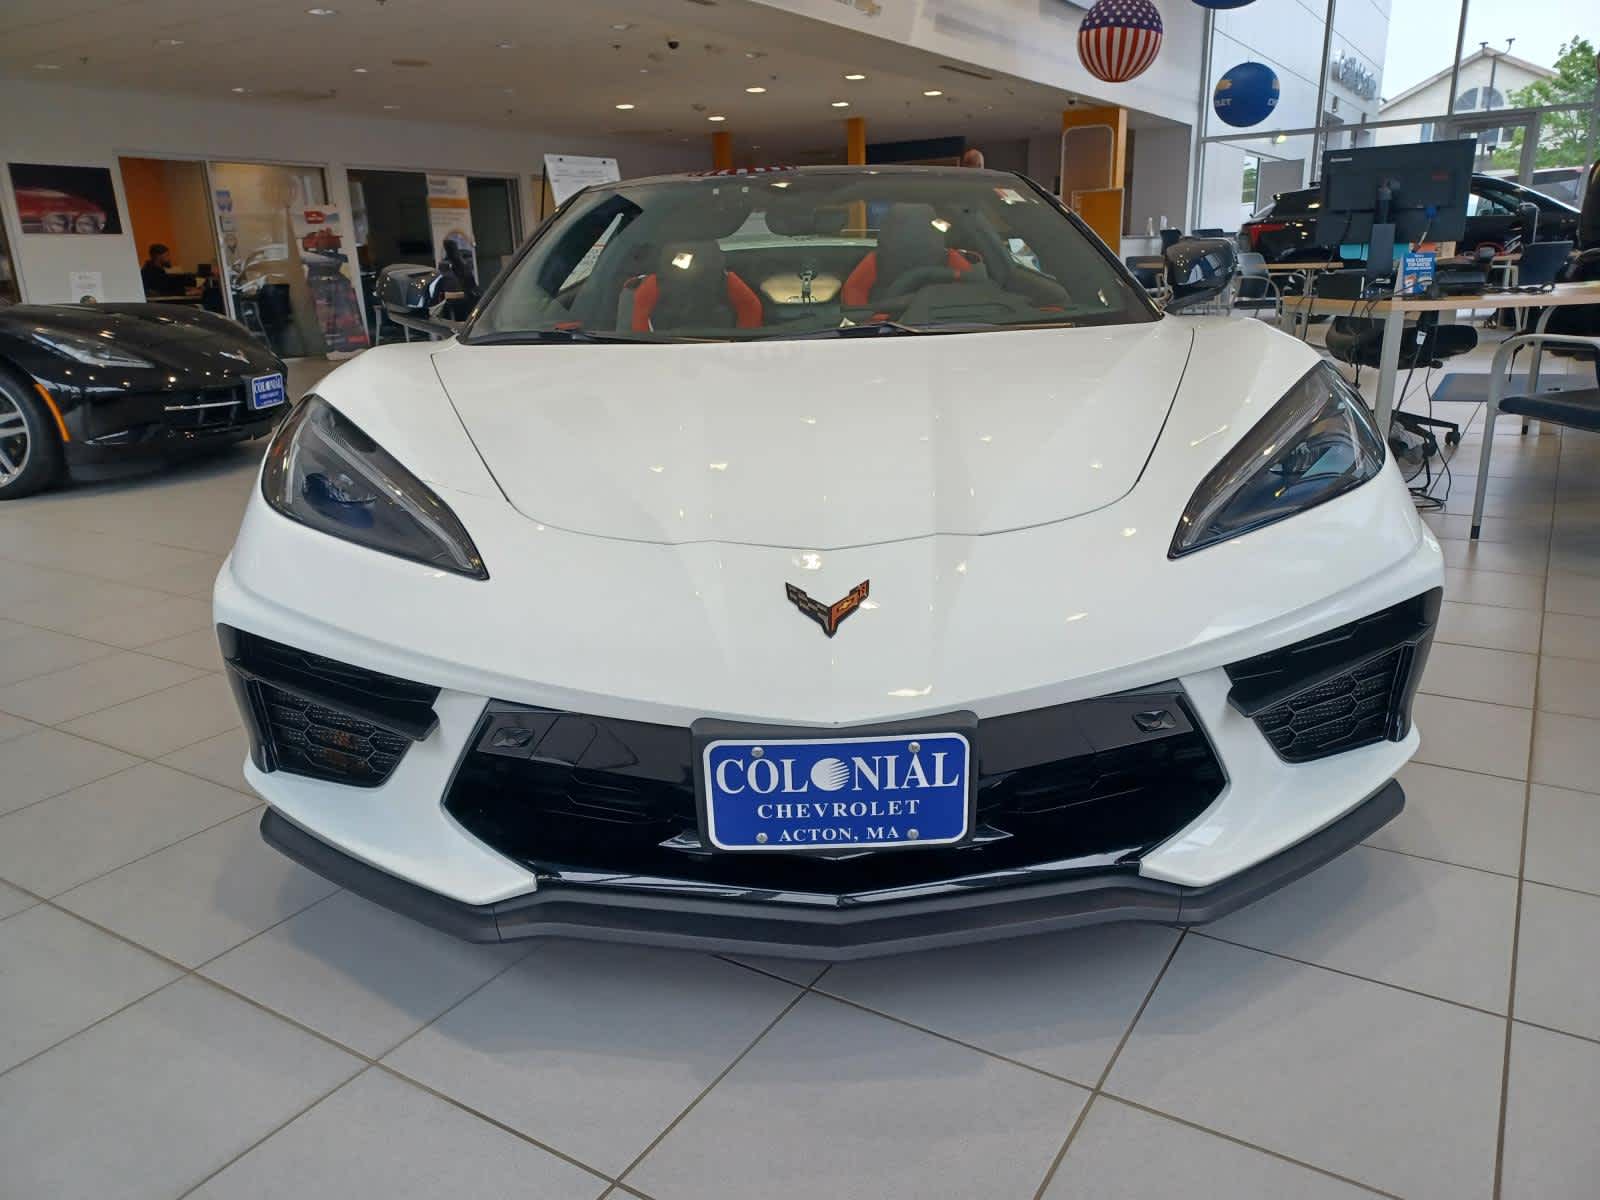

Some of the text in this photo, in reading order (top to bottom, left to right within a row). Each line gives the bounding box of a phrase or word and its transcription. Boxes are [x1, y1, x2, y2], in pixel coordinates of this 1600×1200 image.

[757, 799, 920, 819] CHEVROLET
[778, 826, 900, 842] ACTON, MA
